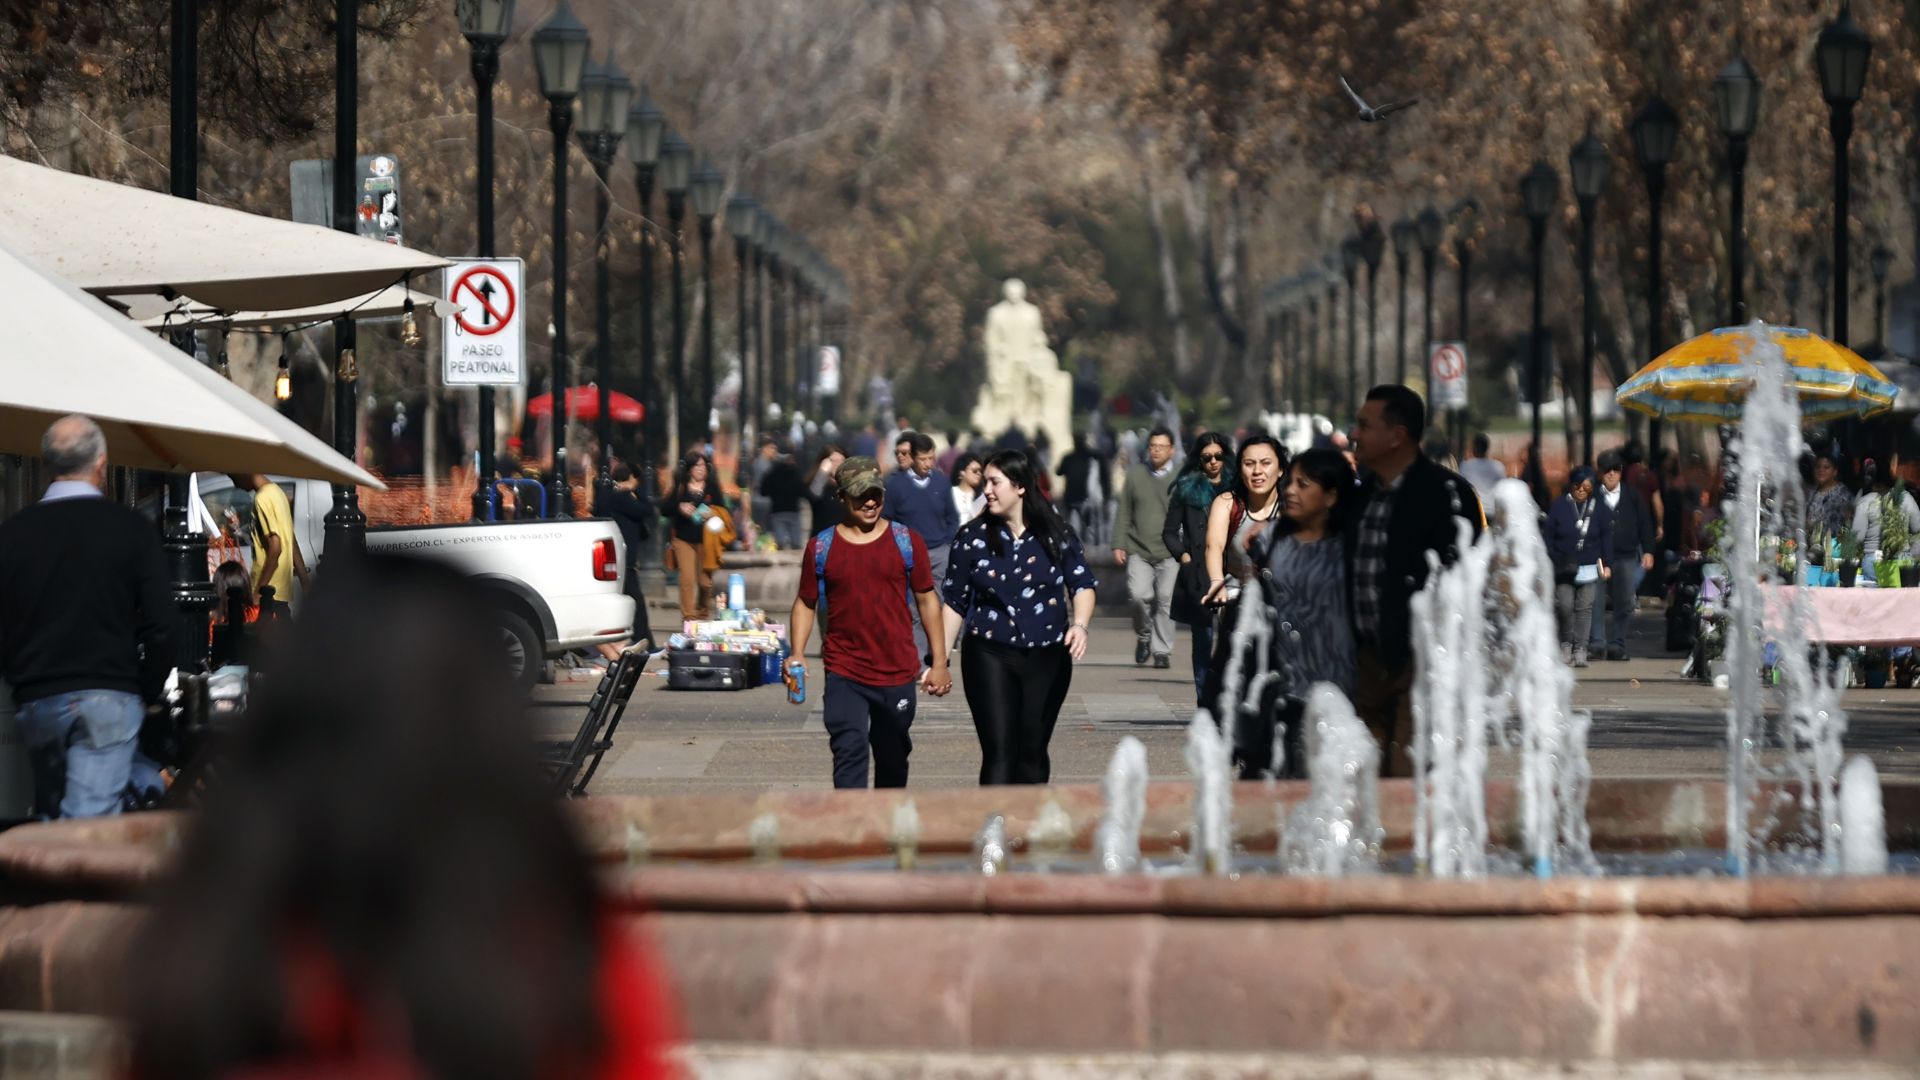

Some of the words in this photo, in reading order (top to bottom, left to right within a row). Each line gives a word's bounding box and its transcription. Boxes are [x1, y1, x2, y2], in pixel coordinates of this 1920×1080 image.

[461, 343, 503, 357] PASEO
[450, 360, 515, 374] PEATONAL
[453, 534, 502, 545] EXPERTOS
[504, 533, 517, 542] EN
[519, 531, 562, 541] ASBESTO
